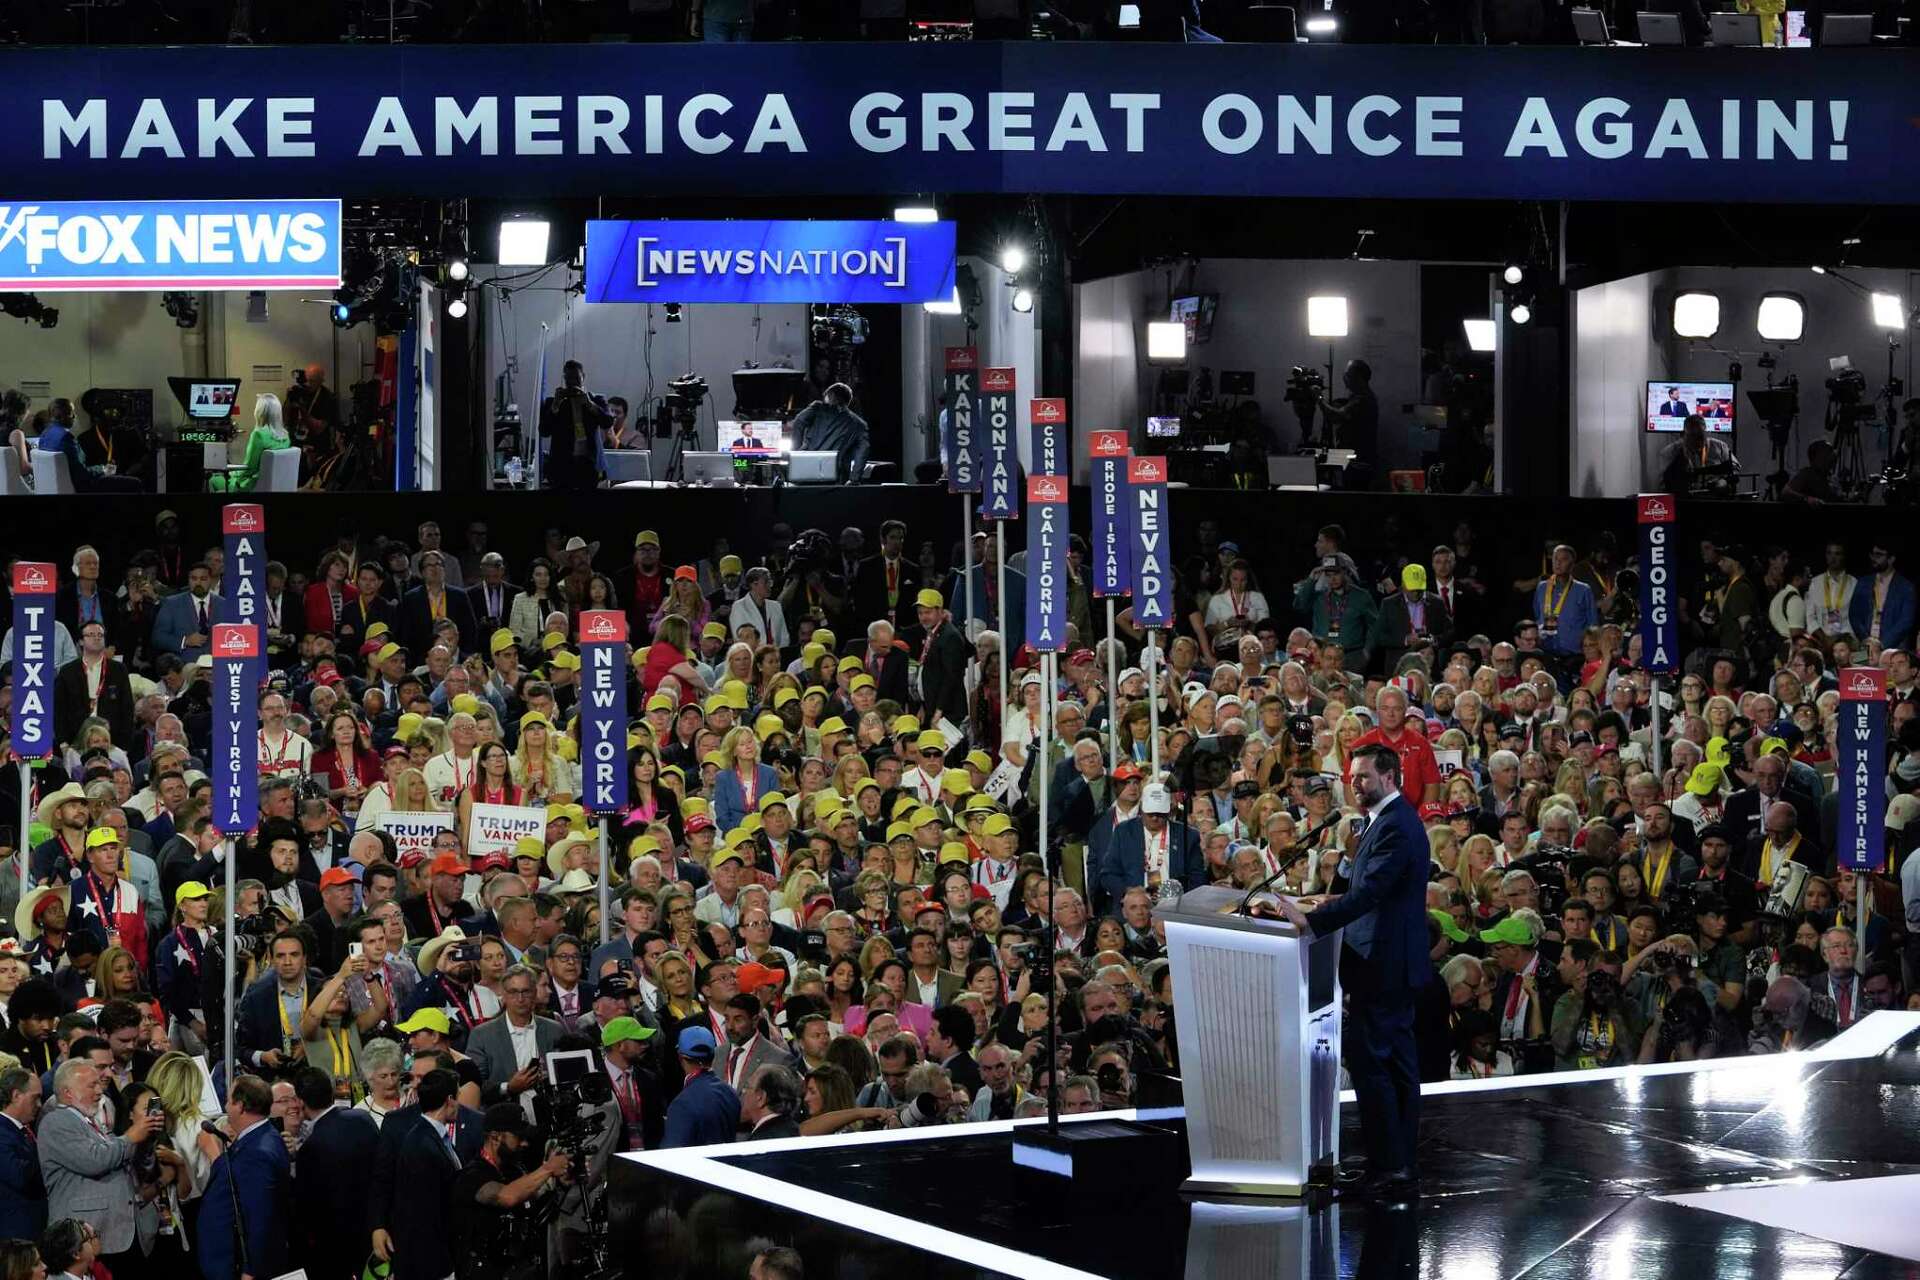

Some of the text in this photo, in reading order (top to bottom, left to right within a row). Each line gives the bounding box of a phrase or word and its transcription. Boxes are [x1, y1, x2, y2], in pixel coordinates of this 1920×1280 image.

[43, 92, 1849, 161] MAKE AMERICA GREAT ONCE AGAIN!
[26, 212, 326, 265] FOX NEWS
[955, 374, 972, 484] KANSAS
[990, 396, 1009, 510] MONTANA
[1104, 460, 1116, 515] RHODE
[1039, 507, 1054, 641] CALIFORNIA
[1106, 522, 1118, 588] ISLAND
[1139, 489, 1163, 617] NEVADA
[1649, 526, 1669, 665] GEORGIA
[20, 607, 45, 743] TEXAS
[592, 648, 616, 804] NEW YORK
[228, 663, 243, 824] WEST VIRGINIA
[1854, 703, 1871, 862] NEW HAMPSHIRE
[477, 816, 540, 831] TRUMP
